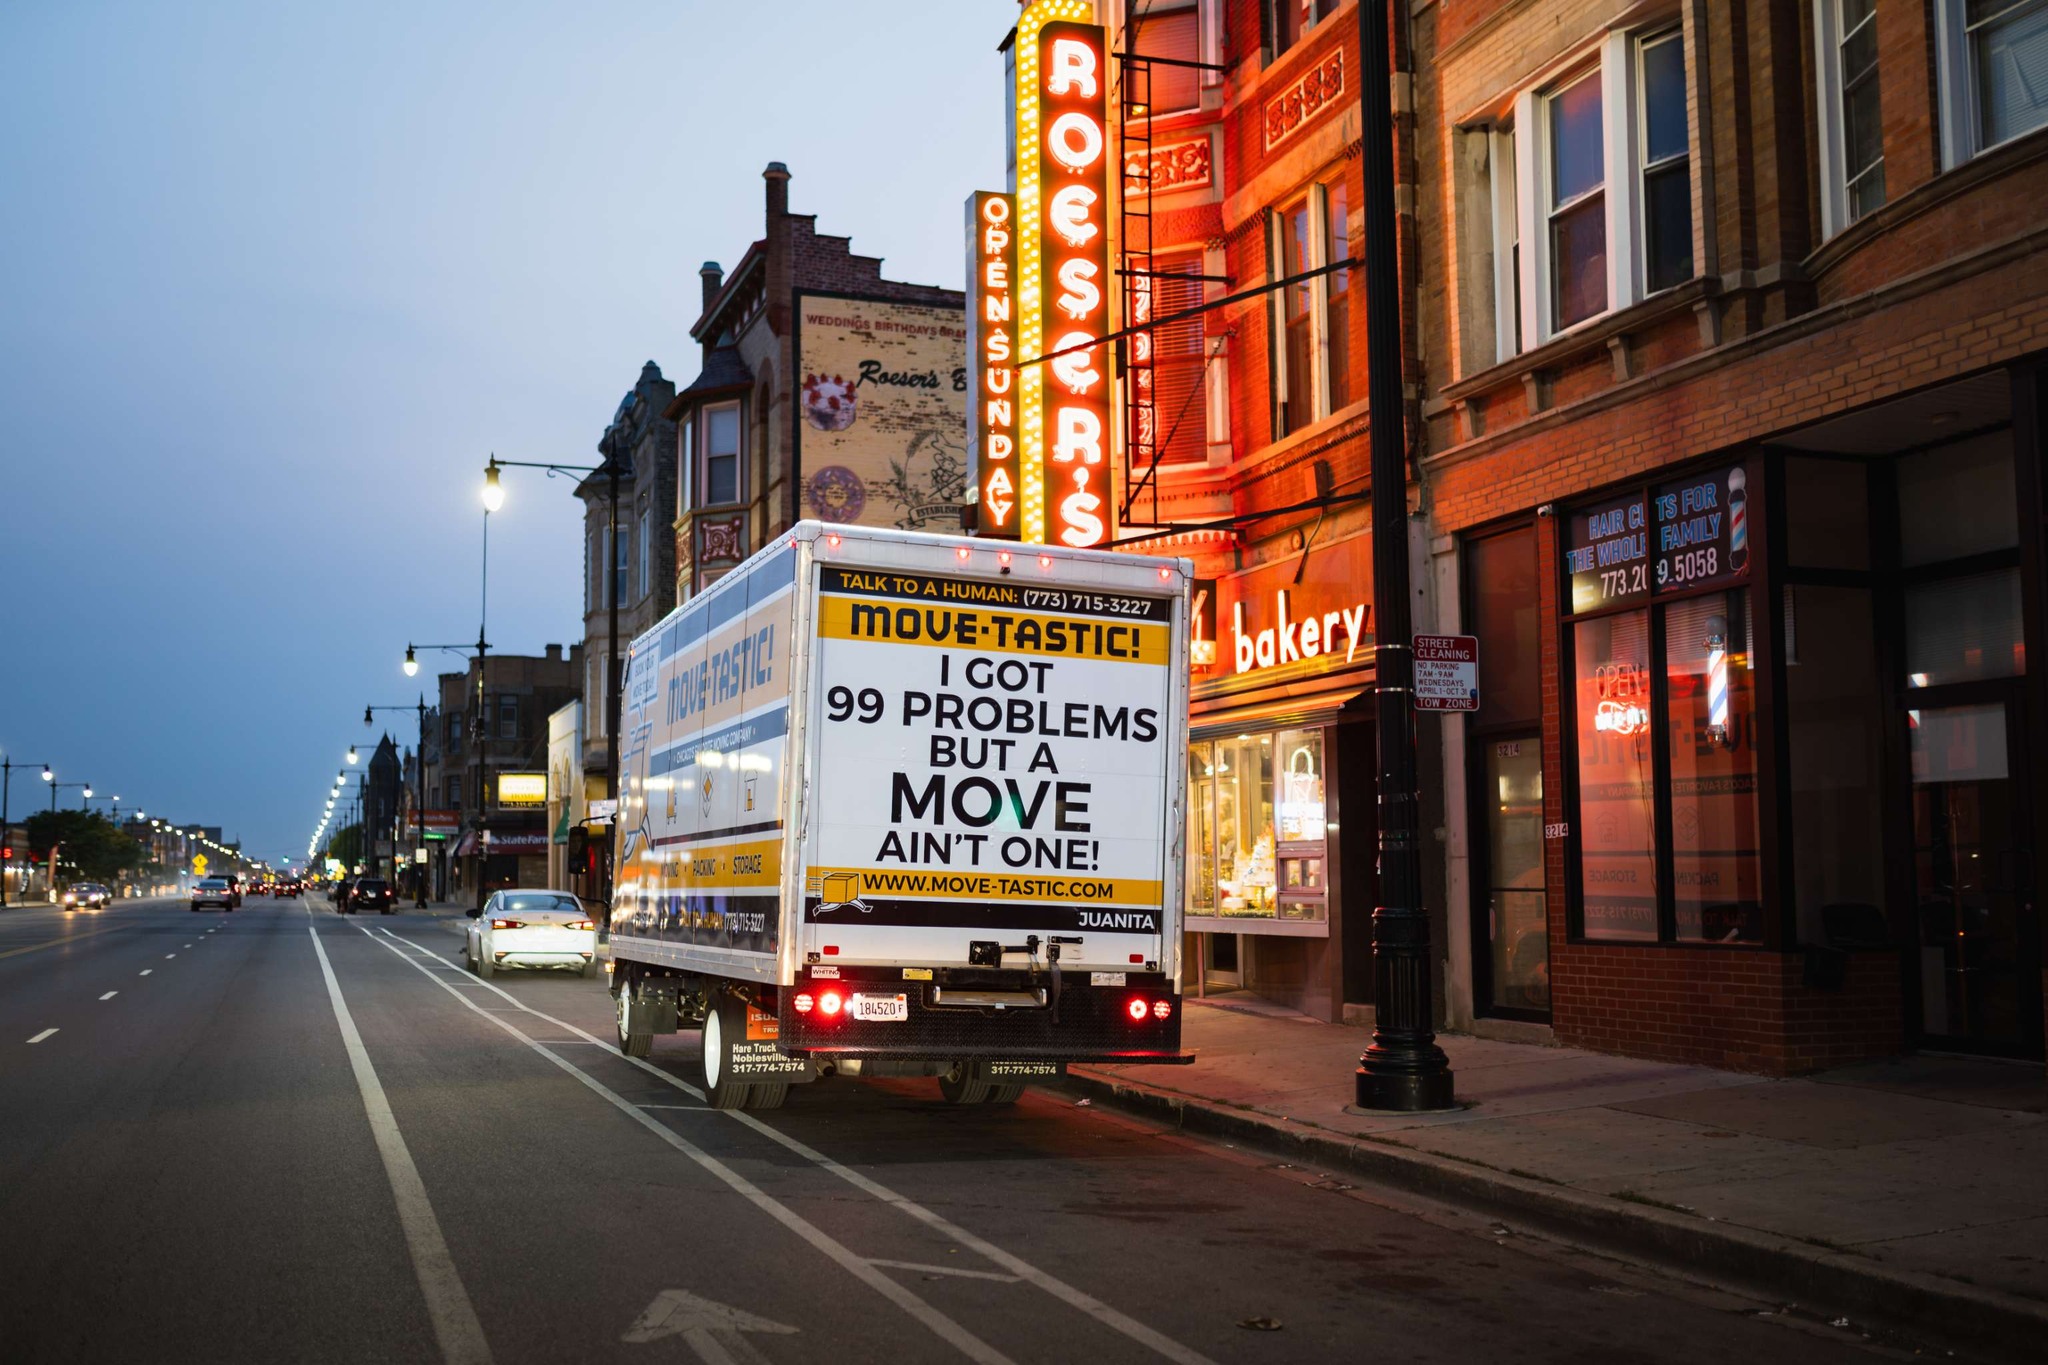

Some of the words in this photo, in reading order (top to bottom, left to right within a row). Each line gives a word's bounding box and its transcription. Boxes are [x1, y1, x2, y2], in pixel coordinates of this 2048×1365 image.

[983, 197, 1010, 322] OPEN
[1047, 39, 1103, 547] ROESER'S
[806, 314, 870, 330] WEDDINGS
[875, 320, 937, 336] BIRTHDAYS
[856, 359, 940, 389] Roeser's
[952, 367, 967, 392] B
[986, 333, 1013, 526] SUNDAY
[915, 505, 960, 518] ESTABLISH
[1589, 509, 1625, 540] HAIR
[1682, 482, 1717, 515] FOR
[1566, 545, 1595, 574] THE
[1661, 512, 1722, 552] FAMILY
[839, 572, 887, 593] TALK
[893, 578, 920, 595] TO
[923, 580, 938, 597] A
[943, 585, 1018, 604] HUMAN:
[1023, 588, 1067, 610] (773)
[1072, 595, 1152, 616] 715-3227
[1234, 589, 1366, 674] bakery
[1417, 649, 1470, 660] CLEANING
[1418, 638, 1454, 649] STREET
[940, 654, 950, 687] I
[965, 657, 1054, 694] GOT
[1431, 663, 1460, 671] PARKING
[1417, 679, 1464, 687] WEDNESDAYS
[1595, 663, 1642, 699] OPEN
[827, 685, 884, 724] 99
[902, 690, 1158, 743] PROBLEMS
[1418, 698, 1440, 708] TOW
[1445, 699, 1473, 709] ZONE
[930, 734, 1016, 771] BUT
[1028, 742, 1059, 775] A
[890, 772, 1092, 833] MOVE
[1546, 823, 1568, 838] 3214
[875, 830, 988, 866] AIN'T
[1000, 836, 1099, 872] ONE!
[693, 858, 716, 876] PACKING
[733, 854, 762, 875] STORAGE
[863, 873, 1113, 899] WWW.MOVE-TASTIC.COM
[739, 912, 765, 933] 715-3227
[1078, 911, 1155, 930] JUANITA
[751, 1013, 778, 1021] ISU
[860, 1002, 896, 1015] 184520
[898, 1004, 903, 1013] F
[732, 1043, 752, 1054] Hare
[754, 1043, 776, 1053] Truck
[732, 1062, 805, 1073] 317-774-7574
[991, 1066, 1056, 1075] 317-774-7574
